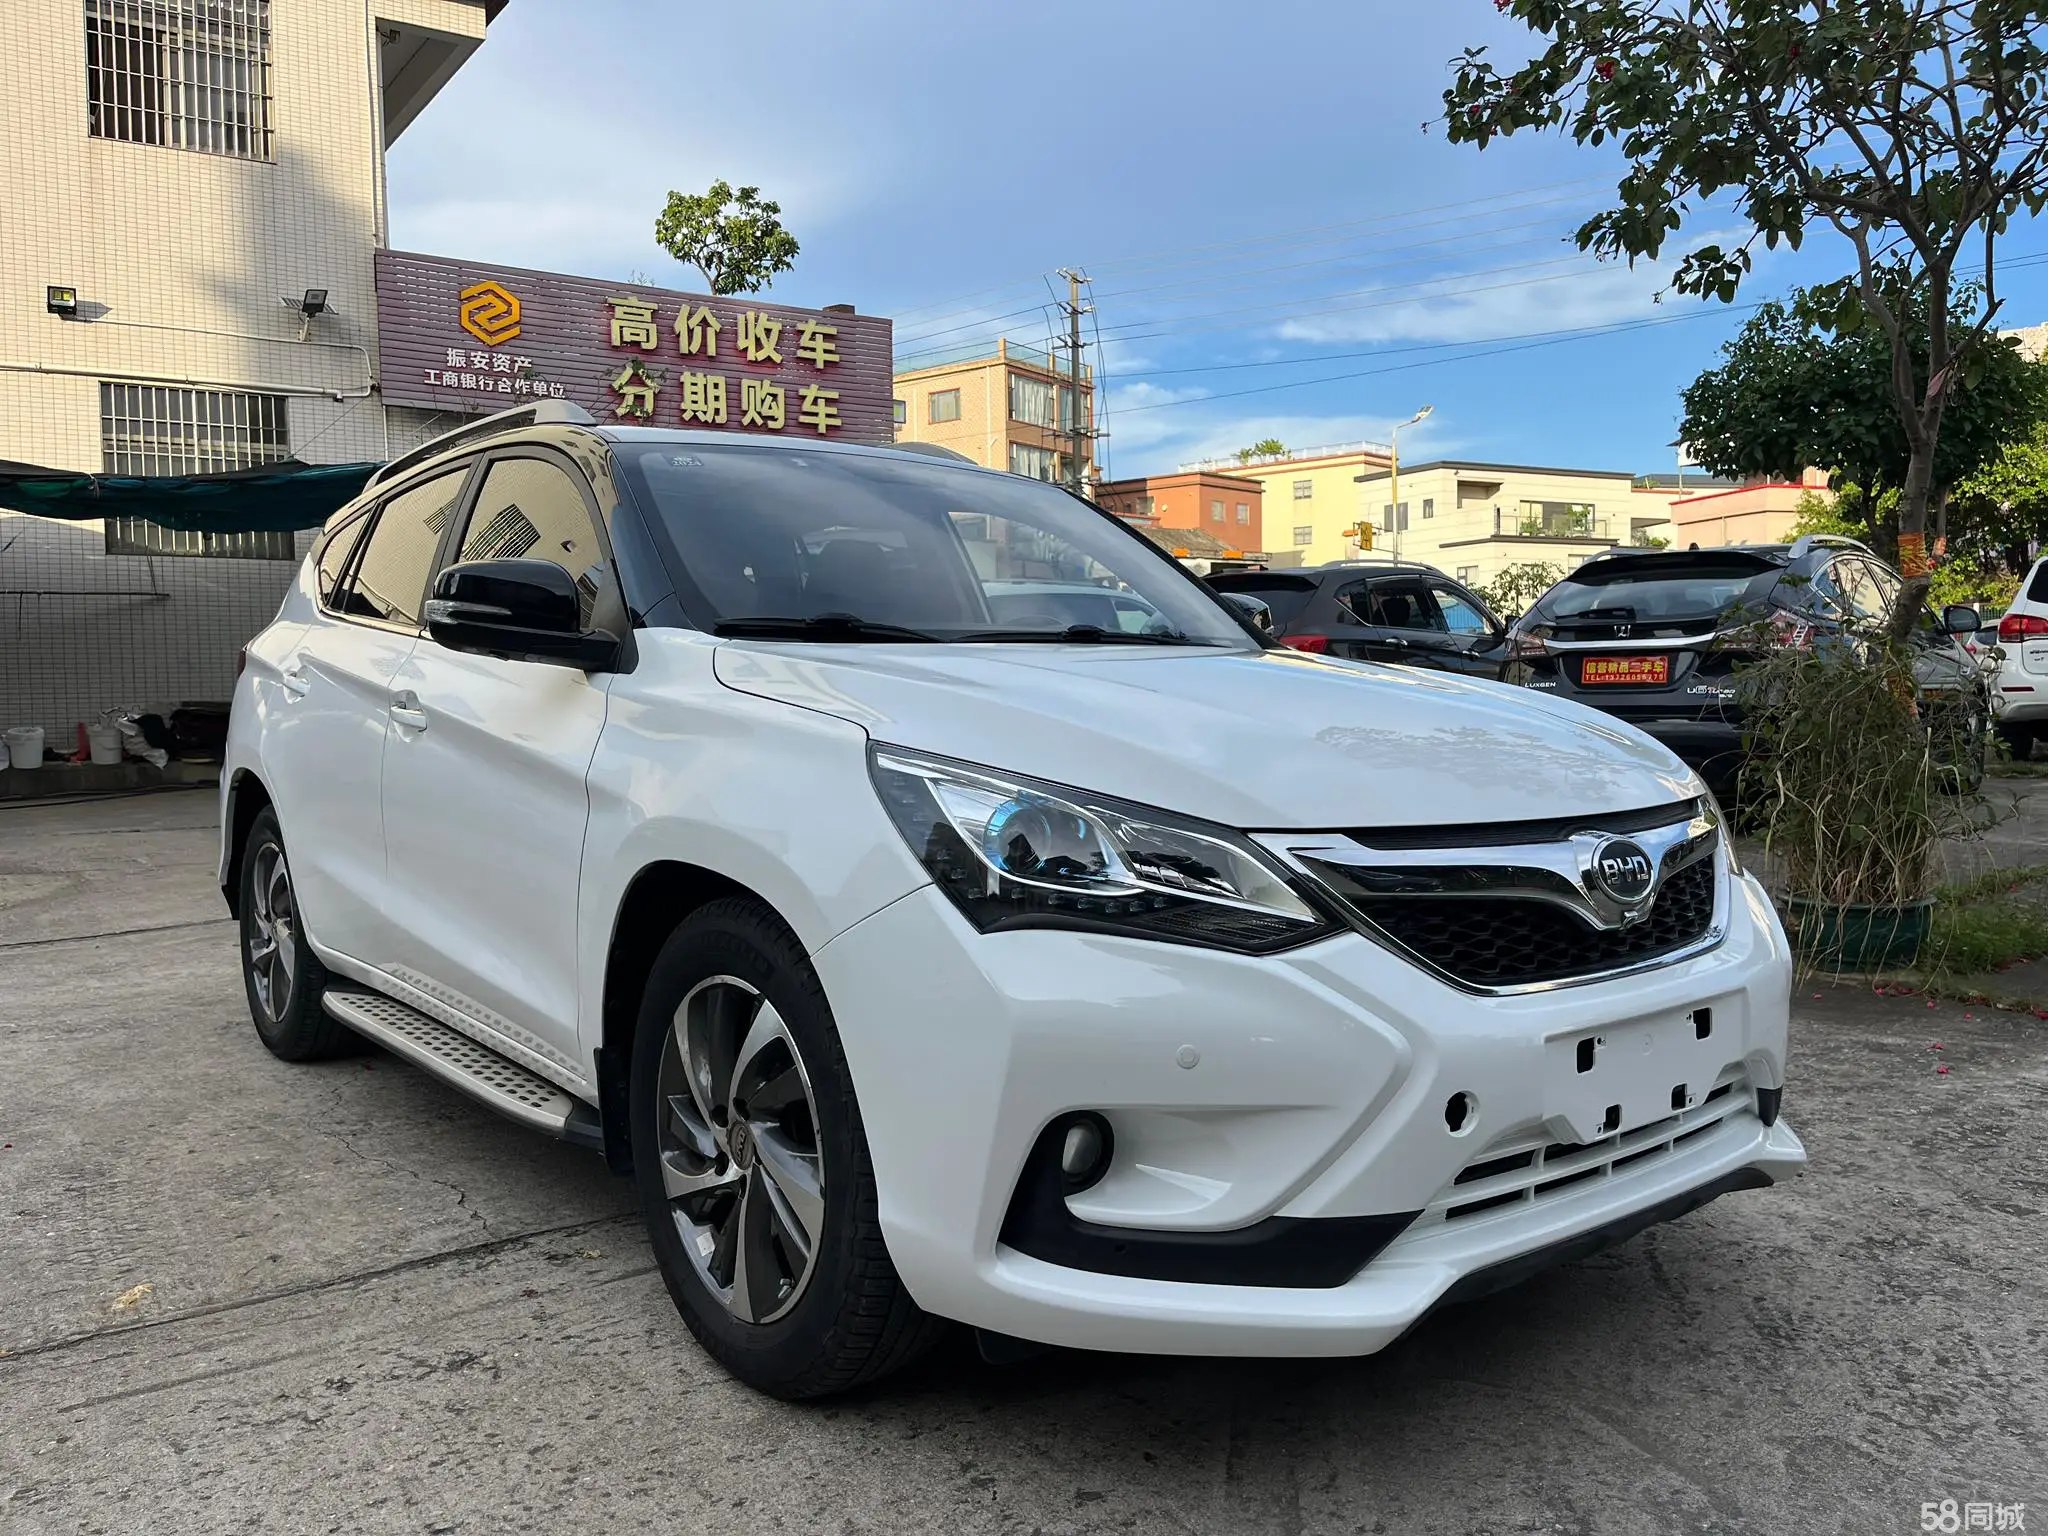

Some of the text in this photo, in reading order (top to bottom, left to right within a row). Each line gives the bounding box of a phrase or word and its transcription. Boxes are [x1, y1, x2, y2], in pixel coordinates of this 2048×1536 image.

[606, 296, 841, 370] 高价收车
[446, 347, 532, 374] 振安资产
[423, 368, 566, 399] 工商银行合作单位
[611, 363, 843, 434] 分期购车
[1602, 855, 1649, 885] BYD
